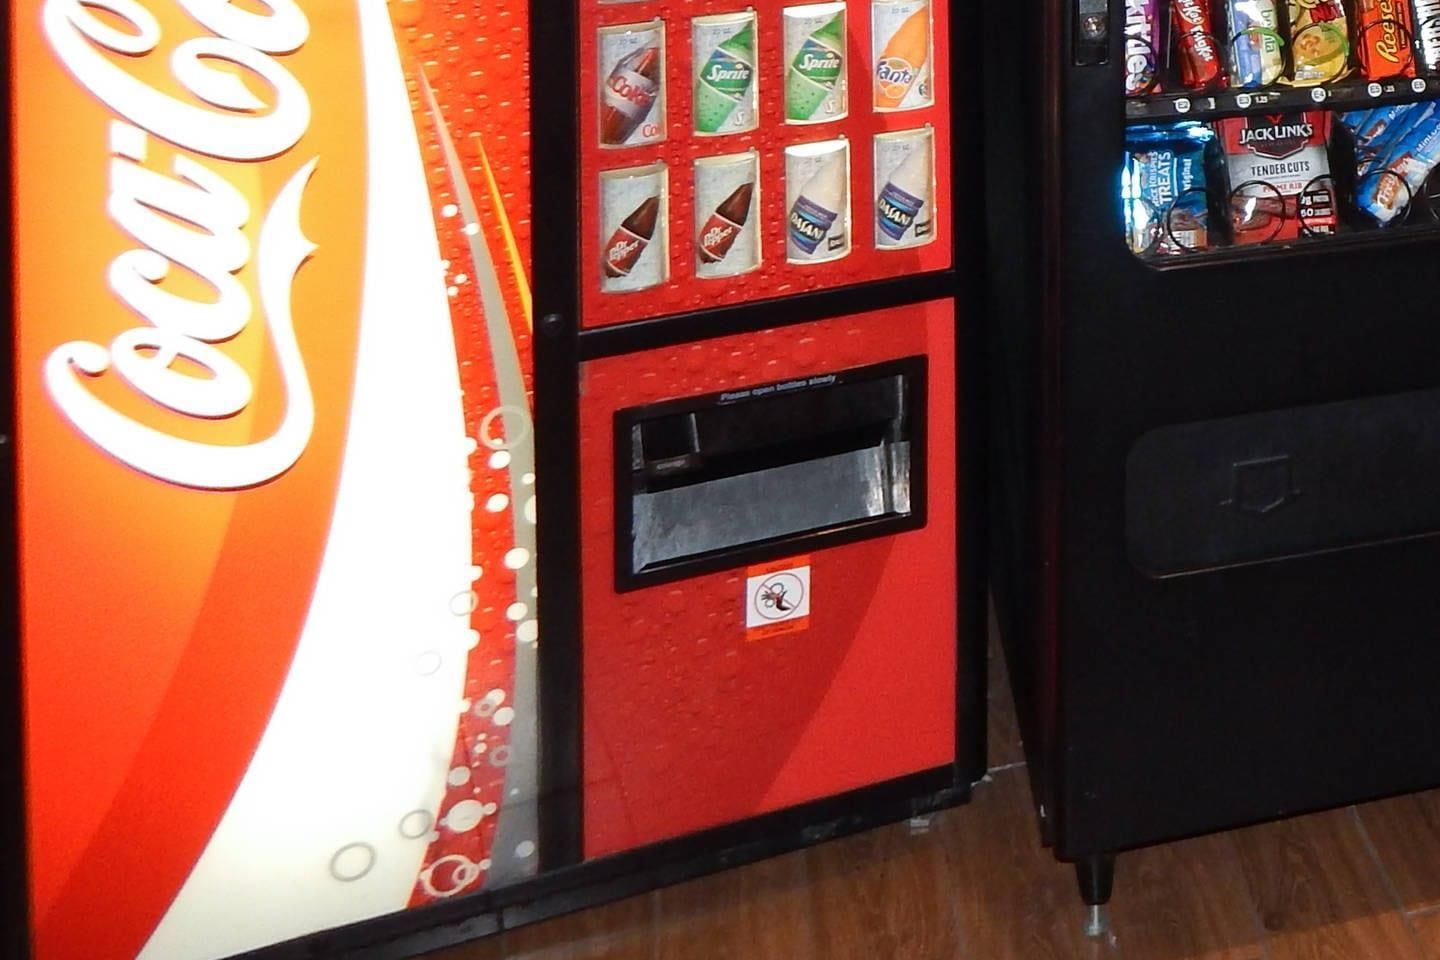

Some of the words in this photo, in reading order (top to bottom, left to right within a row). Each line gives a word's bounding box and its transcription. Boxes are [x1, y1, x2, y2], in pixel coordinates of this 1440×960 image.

[707, 62, 750, 82] Sprite
[799, 53, 841, 70] Sprite
[877, 60, 913, 84] Fanta
[1239, 126, 1275, 145] JACK
[1275, 123, 1313, 139] LINK'S
[1158, 151, 1173, 205] TREATS
[1251, 163, 1287, 177] TENDER
[1288, 161, 1310, 173] CUTS
[878, 198, 910, 227] DASANI
[791, 212, 824, 240] DASANI
